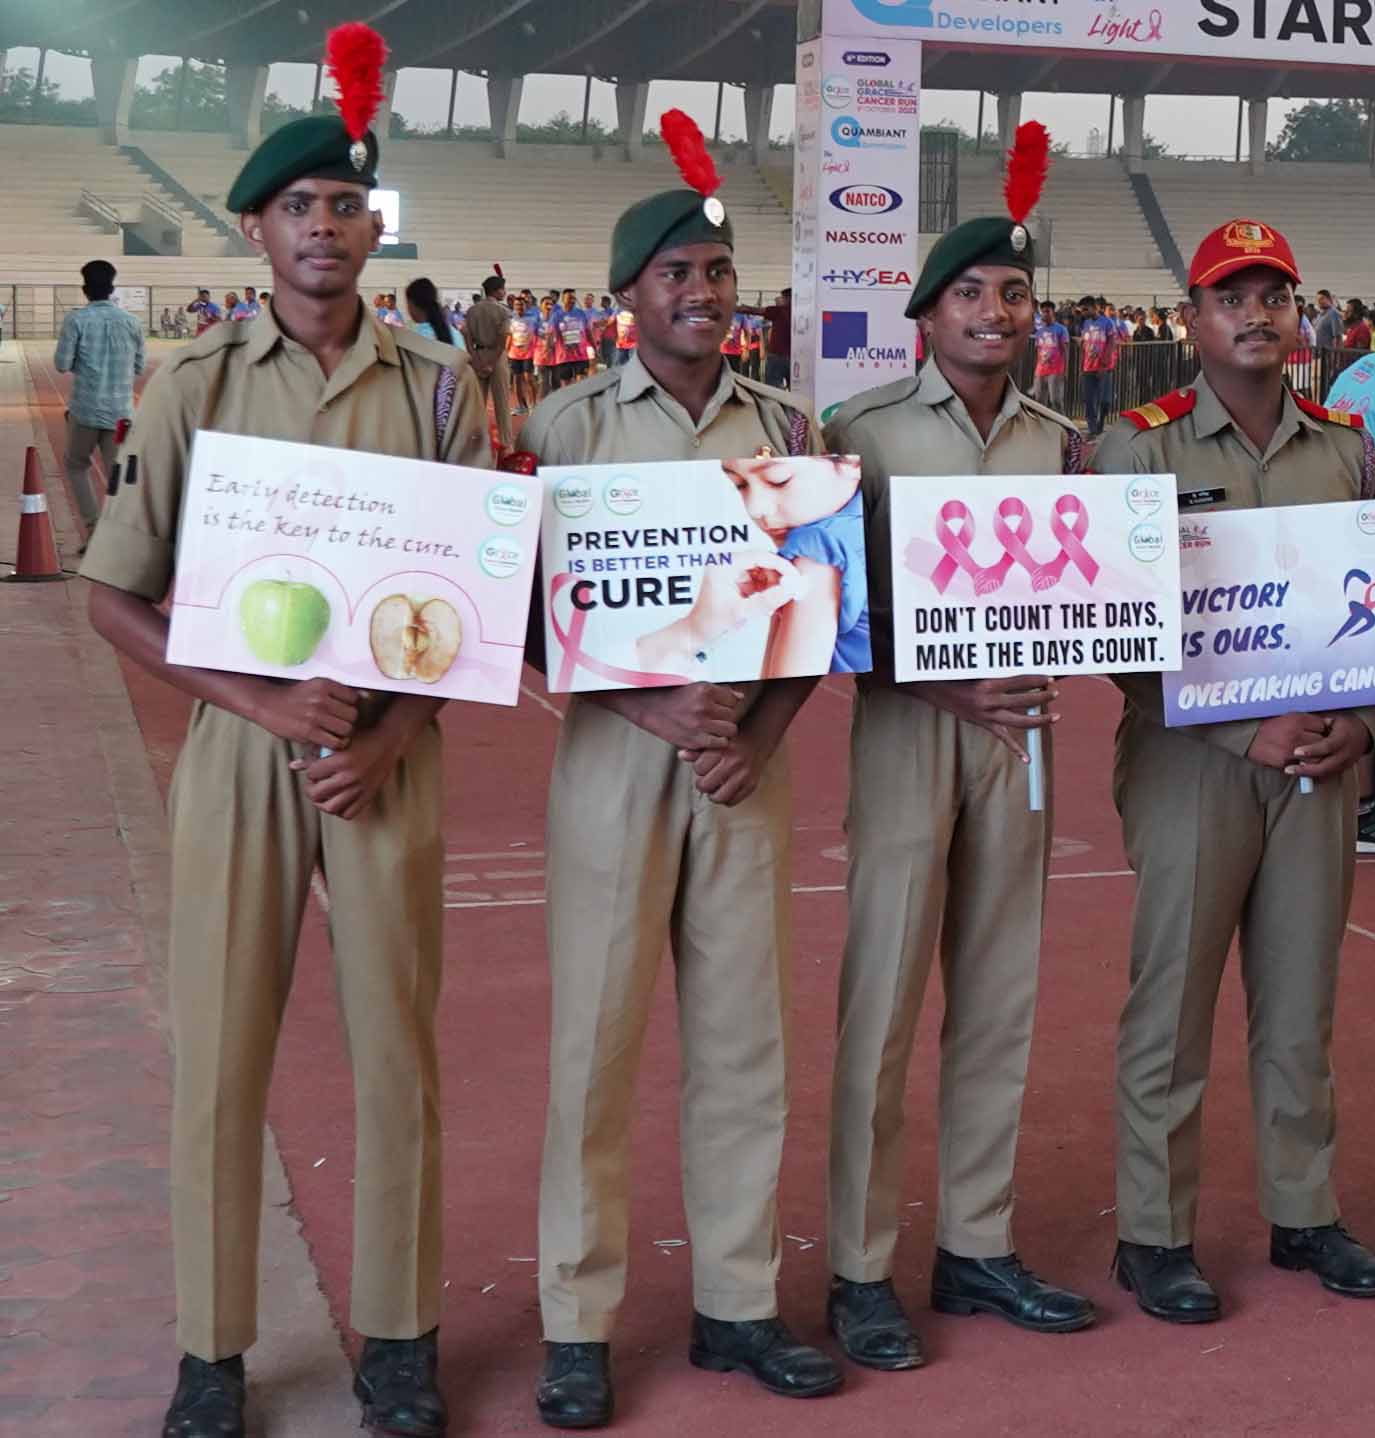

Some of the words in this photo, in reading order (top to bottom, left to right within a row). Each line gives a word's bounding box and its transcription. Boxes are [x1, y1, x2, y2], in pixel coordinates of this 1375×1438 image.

[938, 12, 1063, 36] Developers
[1088, 13, 1141, 44] Light
[857, 96, 896, 105] CANCER
[842, 127, 906, 138] QUAMBIANT
[845, 192, 886, 207] NATCO
[825, 231, 903, 244] NASSCOM
[285, 484, 397, 515] detection
[202, 511, 221, 526] is
[227, 511, 266, 533] the
[273, 515, 320, 550] key
[328, 524, 351, 545] to
[358, 526, 396, 550] the
[403, 539, 461, 558] cure.
[567, 524, 749, 551] PREVENTION
[569, 560, 585, 574] IS
[593, 555, 670, 572] BETTER
[679, 552, 733, 569] THAN
[571, 575, 693, 611] CURE
[1183, 581, 1290, 615] VICTORY
[915, 606, 977, 634] DON'T
[985, 604, 1052, 632] COUNT
[1060, 603, 1097, 629] THE
[1105, 601, 1164, 629] DAYS,
[916, 643, 978, 671] MAKE
[986, 642, 1024, 667] THE
[1032, 640, 1084, 666] DAYS
[1092, 637, 1164, 663] COUNT.
[1214, 624, 1291, 655] OURS.
[1178, 672, 1323, 710] OVERTAKING
